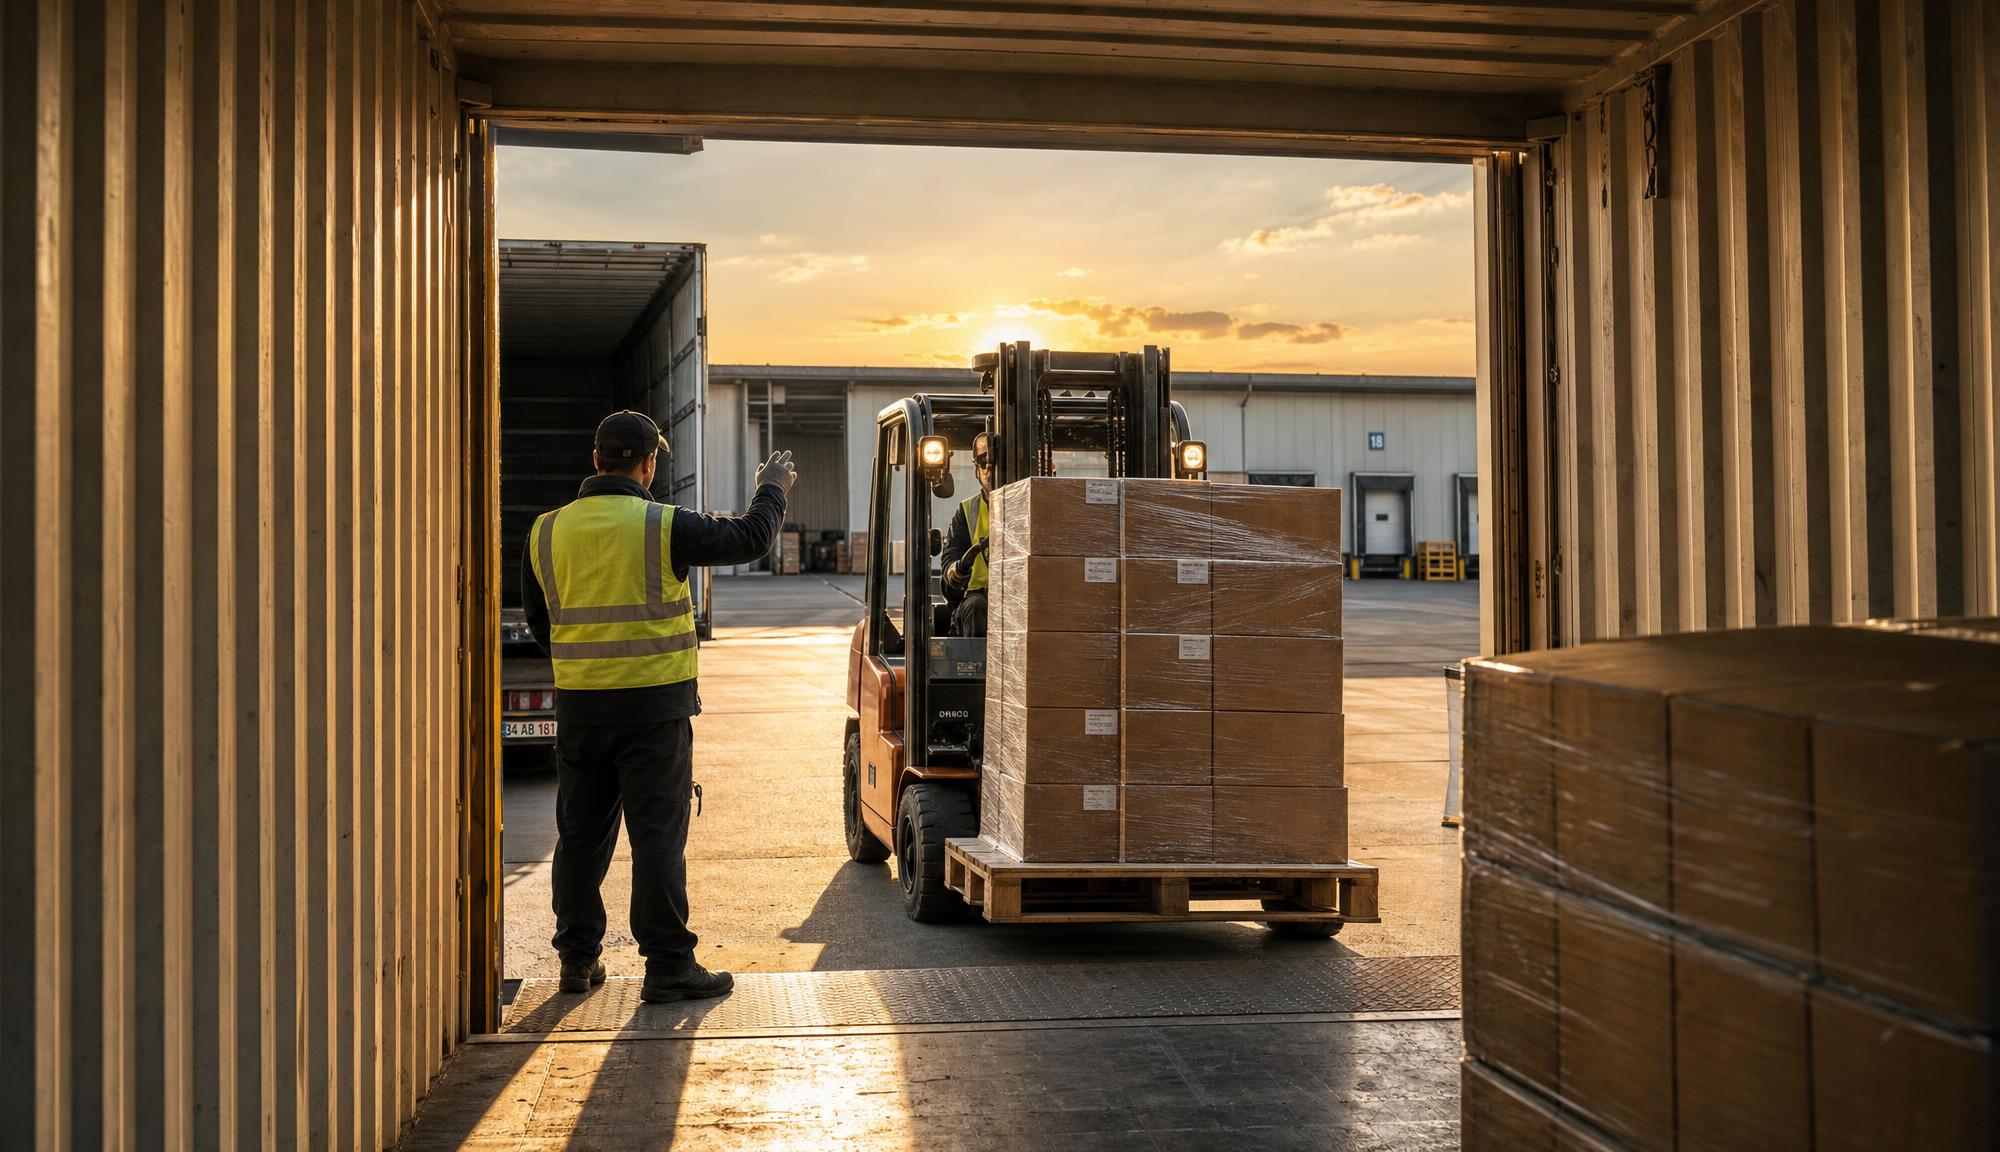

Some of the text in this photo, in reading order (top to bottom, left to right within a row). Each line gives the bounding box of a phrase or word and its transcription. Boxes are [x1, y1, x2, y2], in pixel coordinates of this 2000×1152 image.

[1370, 435, 1383, 448] 18
[506, 723, 555, 736] 34 AB 181
